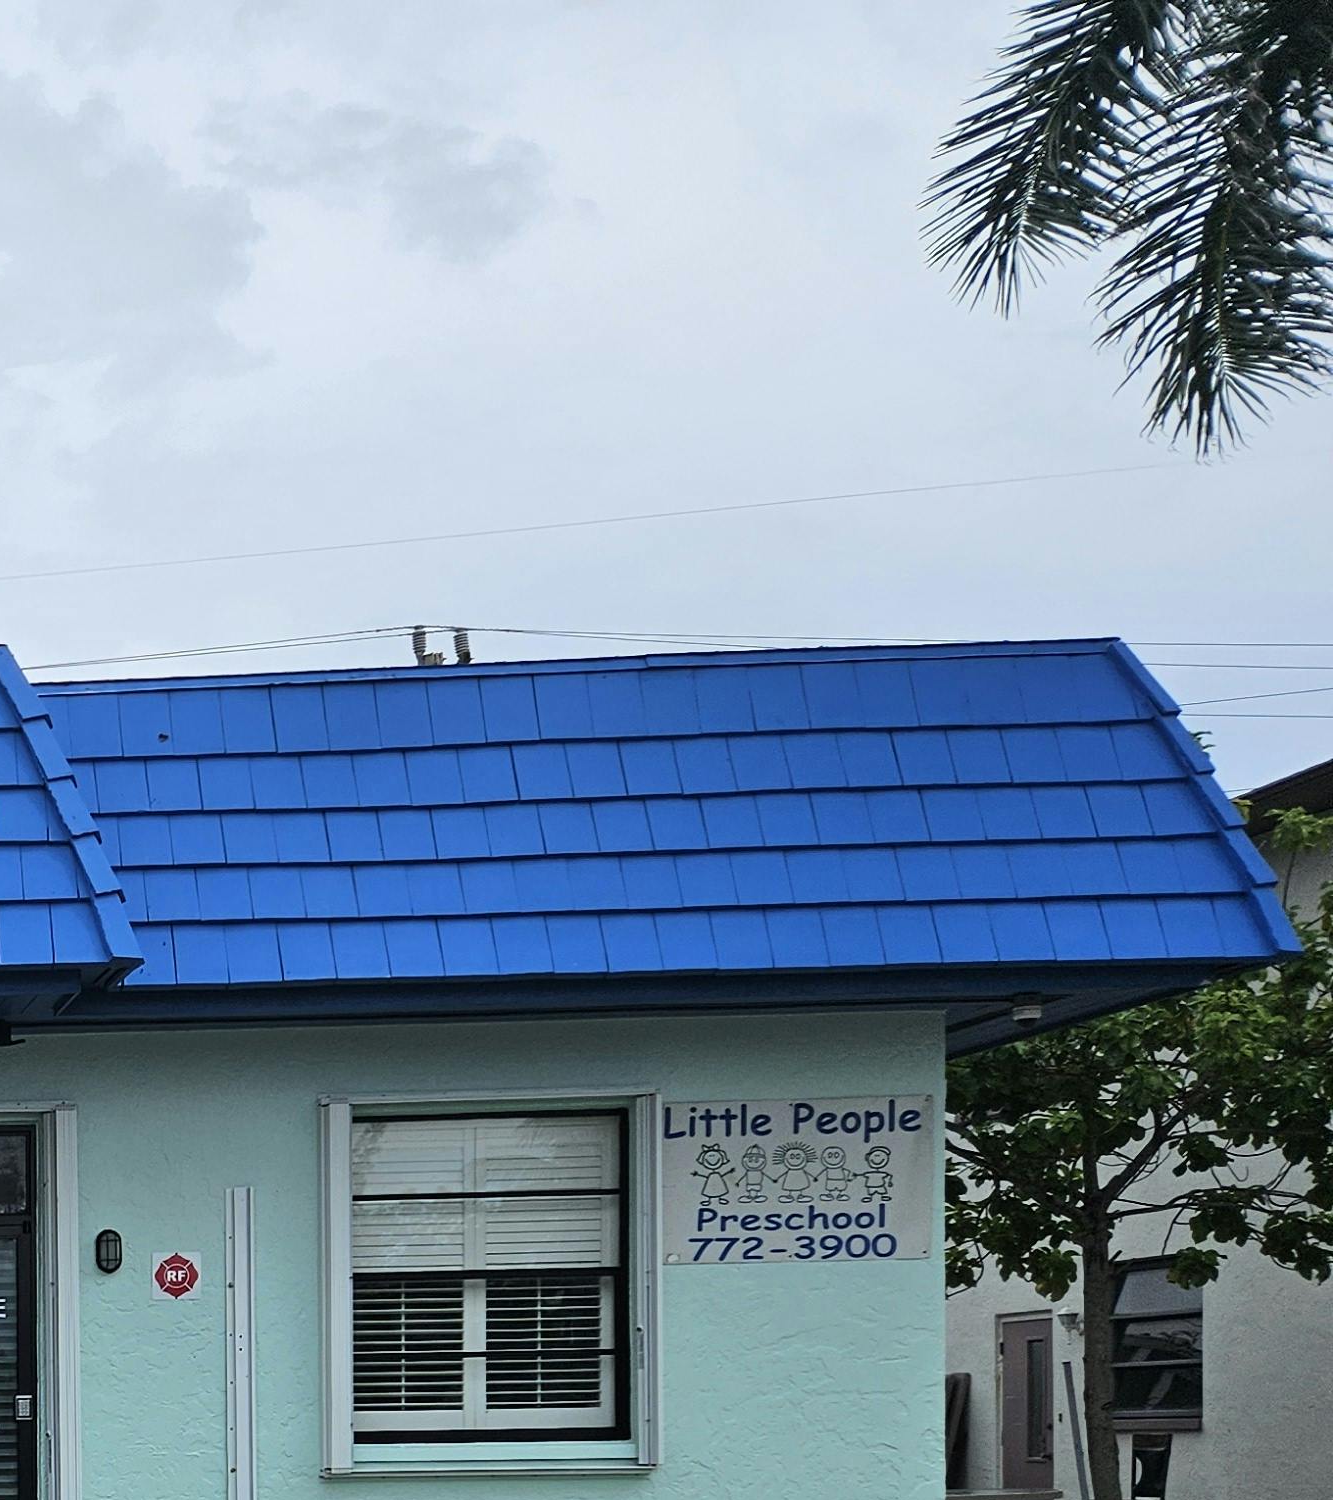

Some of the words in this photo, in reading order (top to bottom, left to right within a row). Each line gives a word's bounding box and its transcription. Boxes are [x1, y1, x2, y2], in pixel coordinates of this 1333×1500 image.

[663, 1103, 773, 1139] Little
[792, 1099, 922, 1143] People
[697, 1203, 886, 1232] Preschool
[688, 1233, 898, 1261] 772-3900
[166, 1270, 187, 1282] RF
